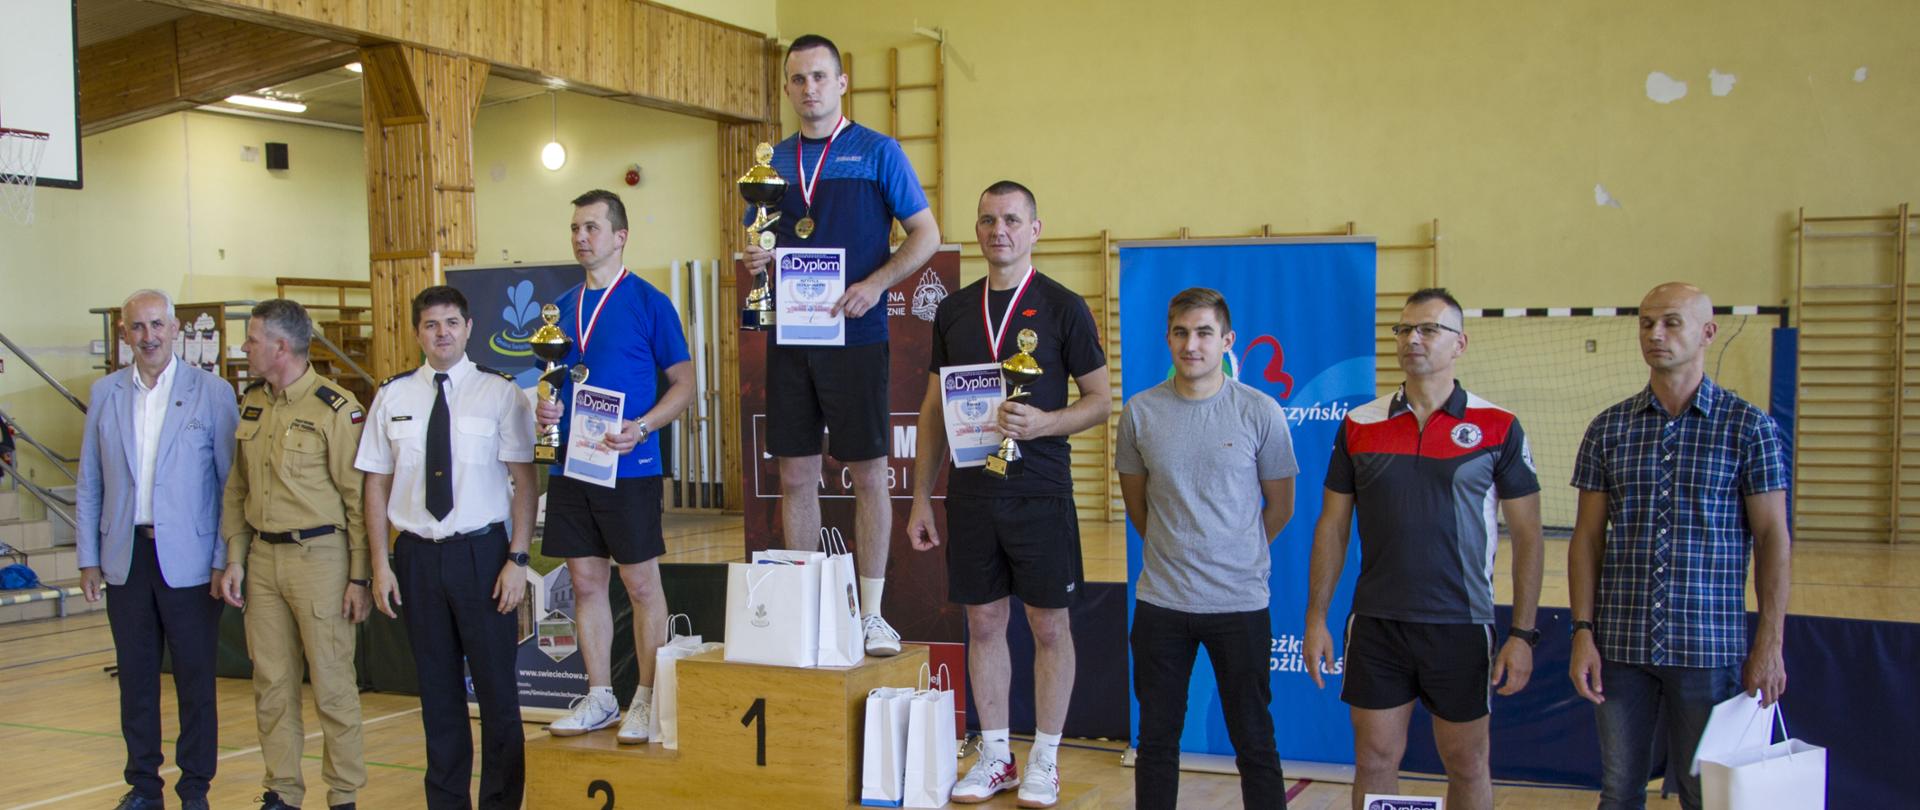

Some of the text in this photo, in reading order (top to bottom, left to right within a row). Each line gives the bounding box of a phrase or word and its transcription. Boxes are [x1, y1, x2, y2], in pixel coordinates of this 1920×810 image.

[792, 257, 840, 273] Dyplom
[955, 375, 1001, 391] Dyplom
[583, 394, 619, 413] Dyplom
[740, 698, 766, 766] 1
